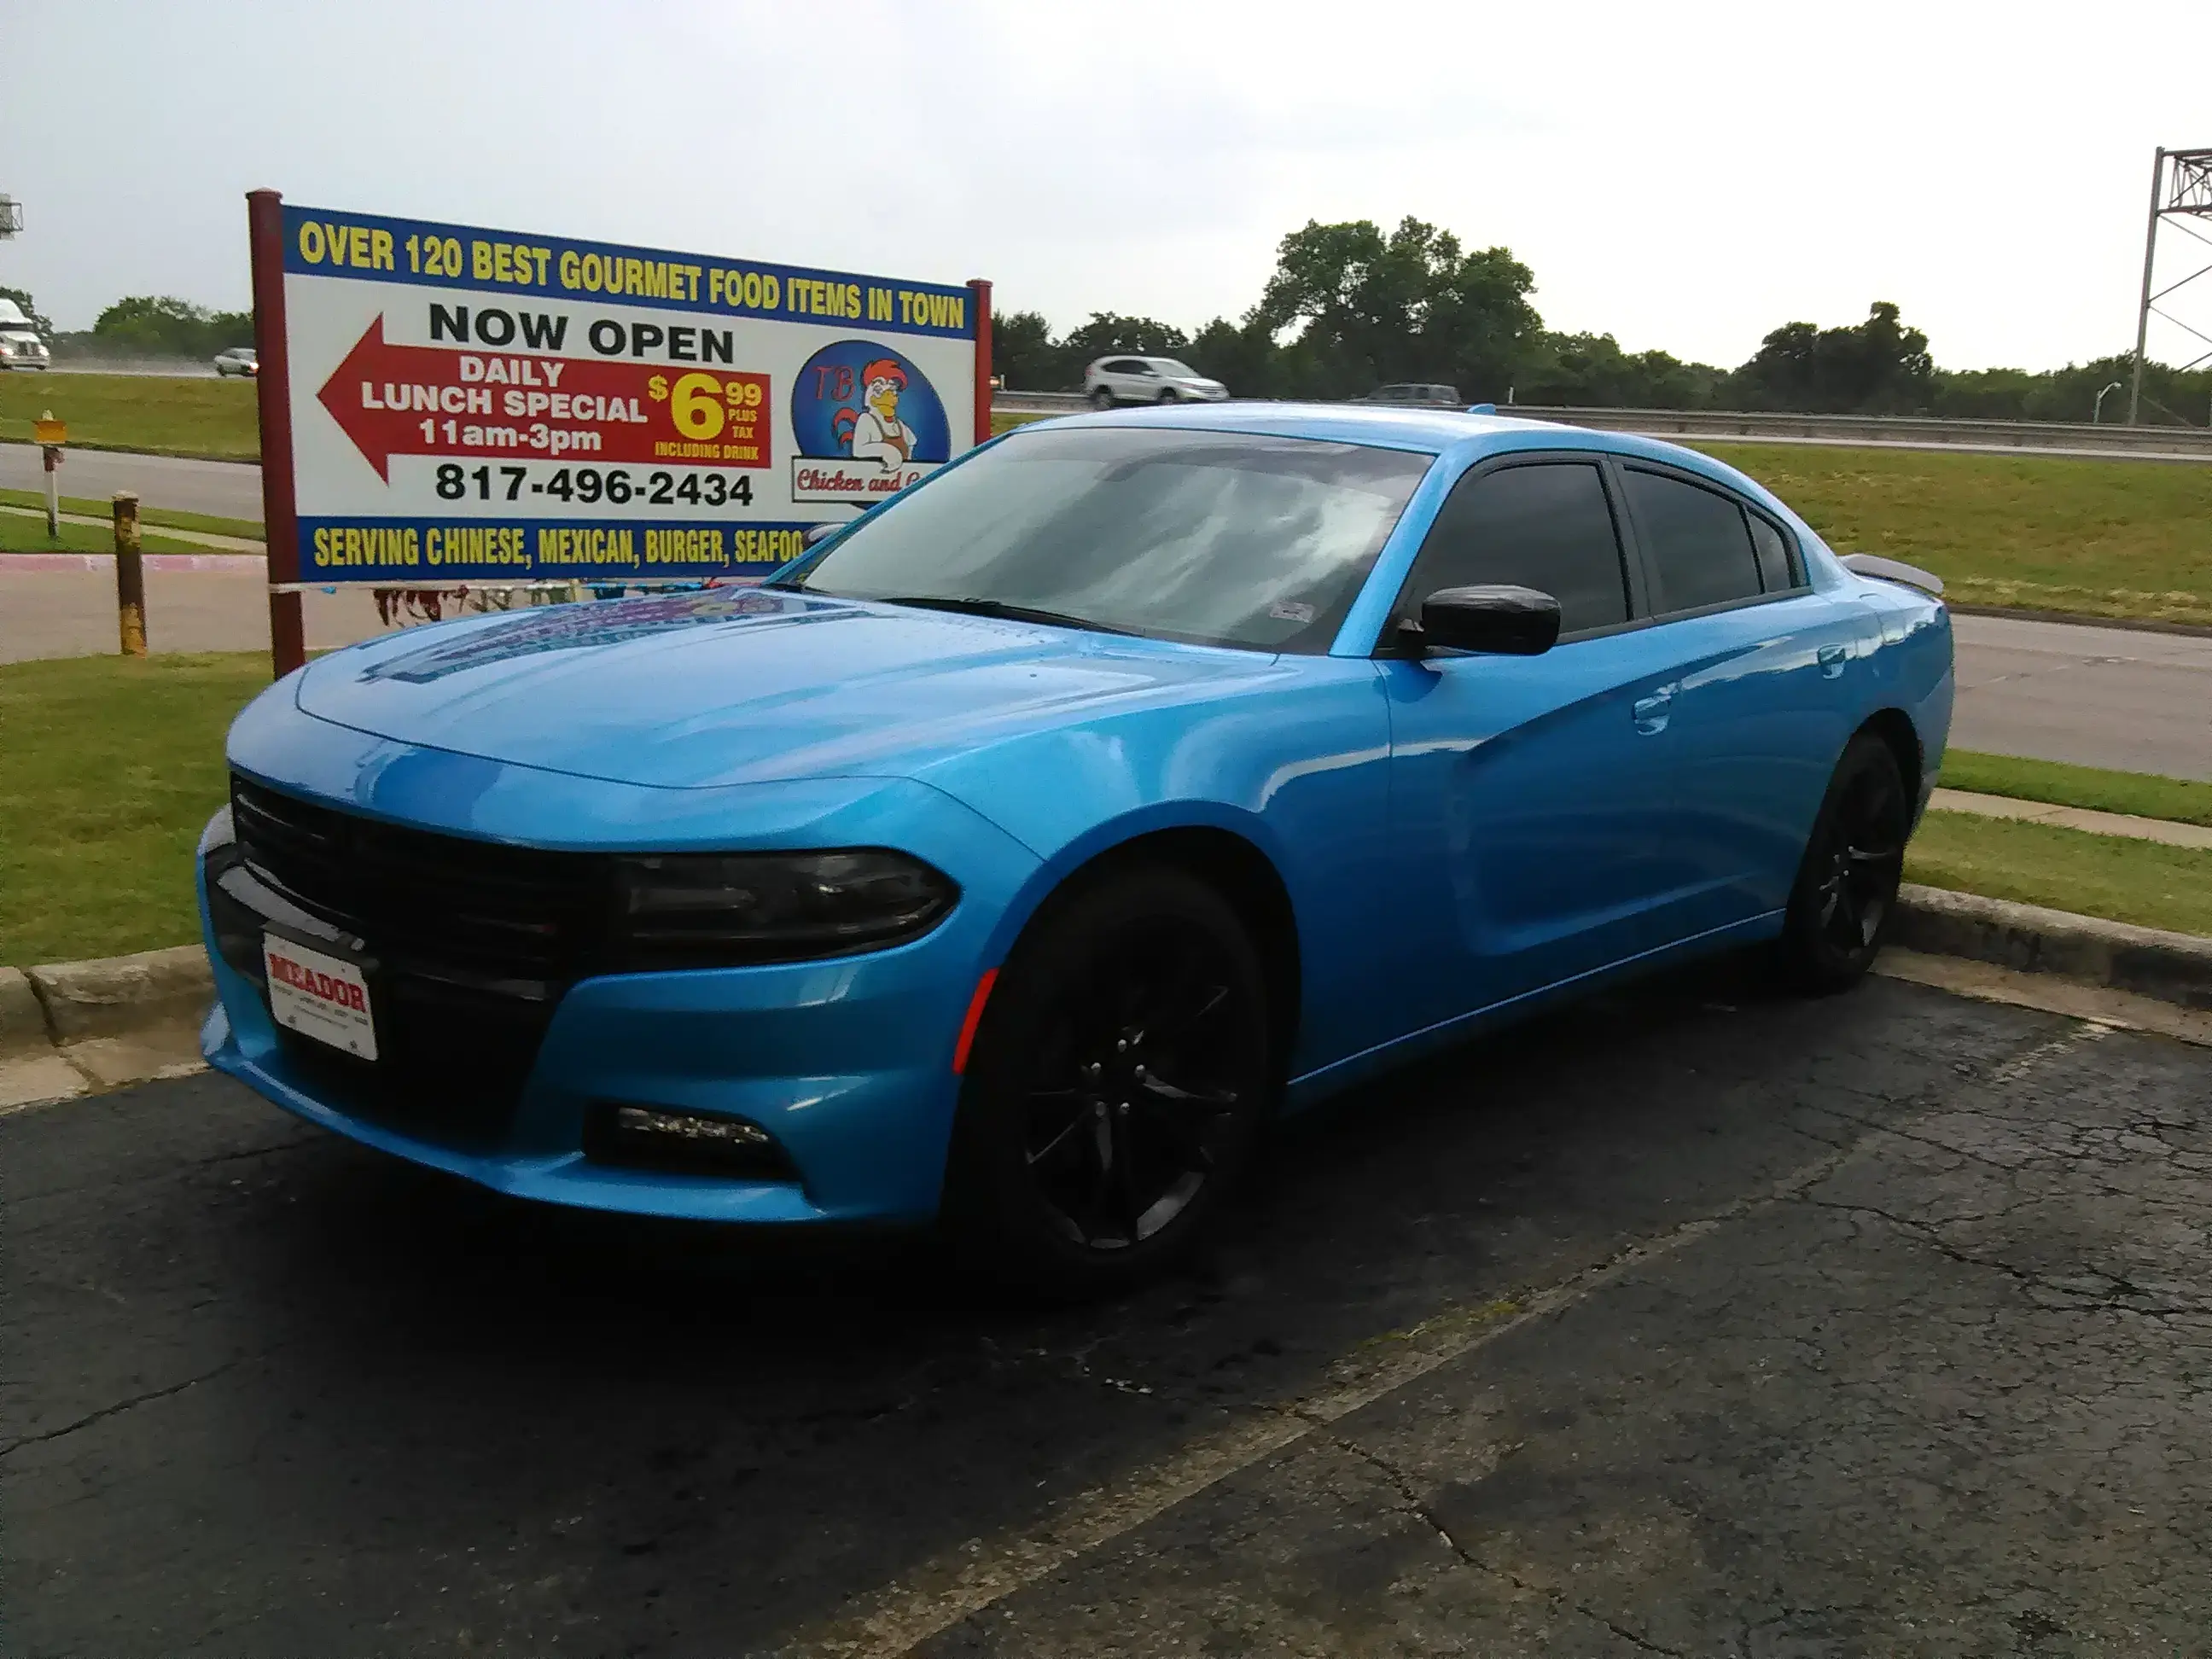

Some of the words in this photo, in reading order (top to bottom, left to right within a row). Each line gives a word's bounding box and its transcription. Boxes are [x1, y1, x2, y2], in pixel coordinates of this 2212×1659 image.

[299, 221, 393, 271] OVER
[405, 234, 462, 278] 120
[472, 241, 551, 286] BEST
[560, 250, 702, 303] GOURMET
[709, 268, 780, 310] FOOD
[788, 277, 861, 321] ITEMS
[869, 287, 893, 322] IN
[899, 291, 964, 329] TOWN
[429, 303, 568, 351] NOW
[588, 319, 734, 364] OPEN
[459, 356, 565, 388] DAILY
[362, 381, 492, 416] LUNCH
[504, 389, 649, 423] SPECIAL
[728, 409, 758, 422] PLUS
[419, 419, 602, 455] 11am-3pm
[655, 441, 720, 458] INCLUDING
[723, 445, 760, 460] DRINK
[732, 426, 754, 439] TAX
[436, 463, 754, 507] 817-496-2434
[797, 469, 864, 492] Chicken
[868, 471, 902, 492] and
[314, 527, 418, 568] SERVING
[426, 527, 533, 570] CHINESE,
[538, 528, 640, 569] MEXICAN,
[646, 529, 730, 569] BURGER,
[268, 953, 368, 1014] MEADOR
